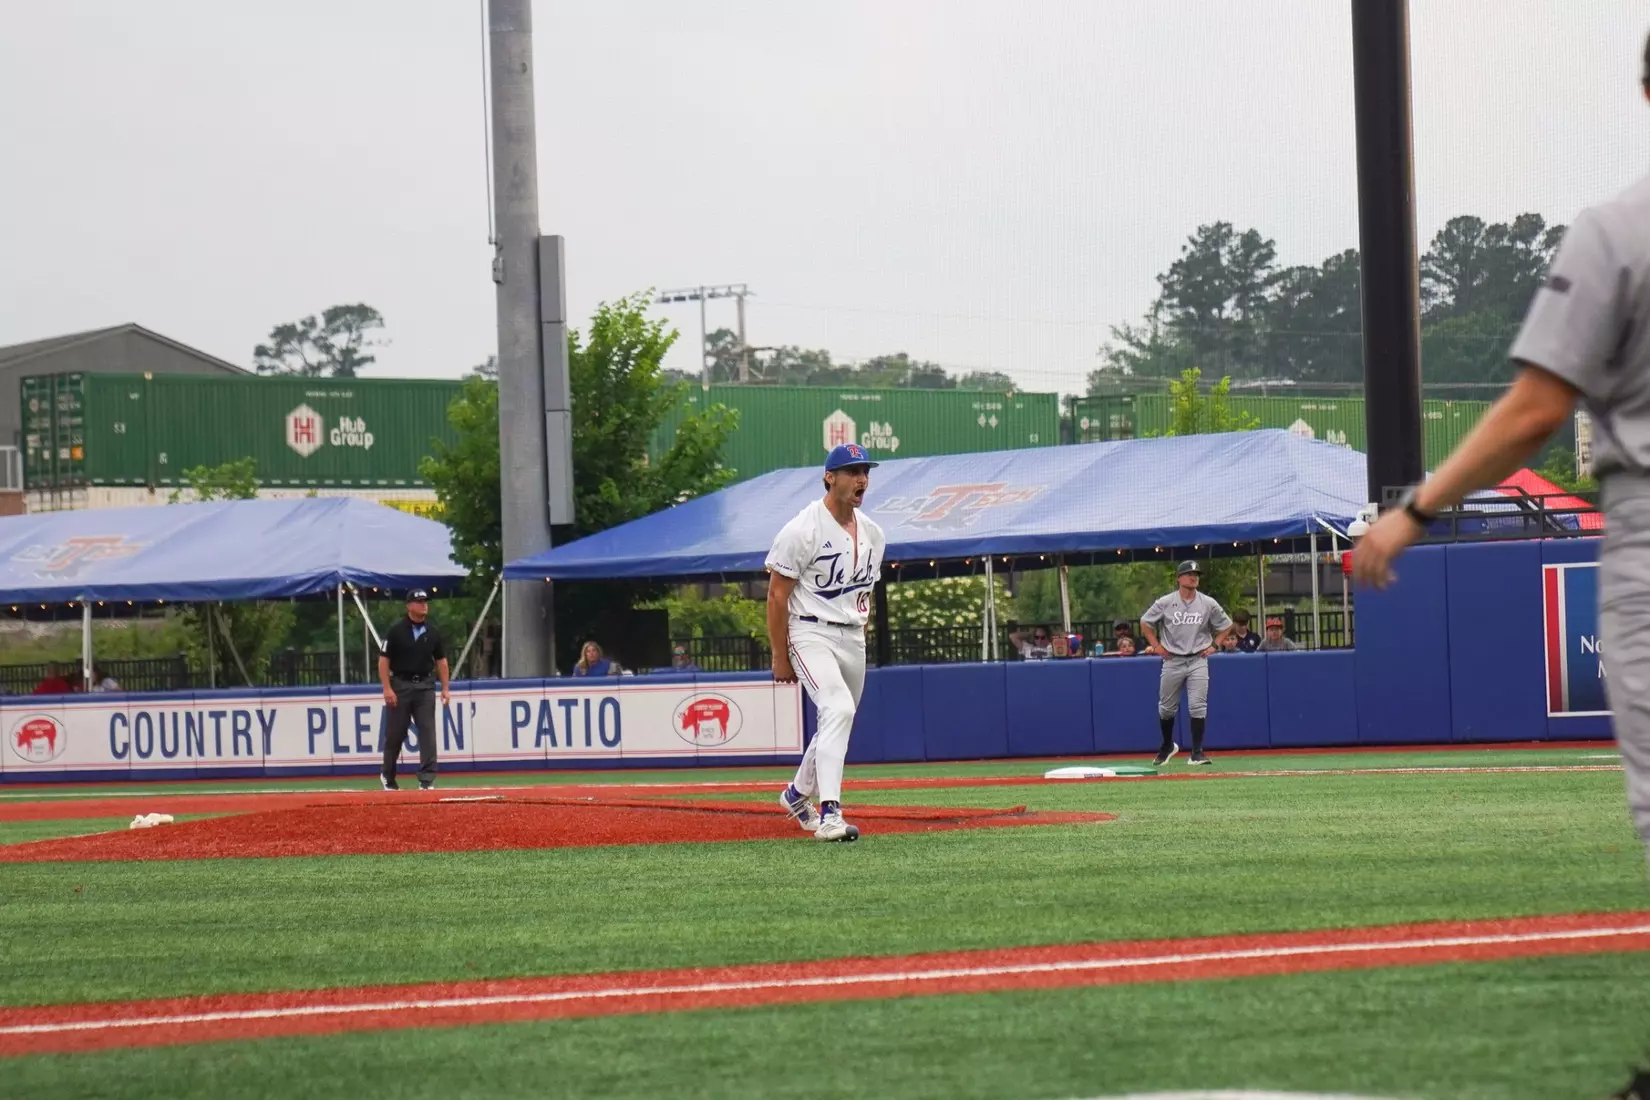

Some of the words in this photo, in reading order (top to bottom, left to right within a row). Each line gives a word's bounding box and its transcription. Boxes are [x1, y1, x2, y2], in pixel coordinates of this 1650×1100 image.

[340, 416, 366, 433] Hub
[330, 428, 374, 450] Group
[862, 432, 899, 452] Group
[1172, 611, 1204, 626] State
[109, 709, 277, 760] COUNTRY
[306, 702, 476, 755] PLEN'
[510, 696, 622, 749] PATIO
